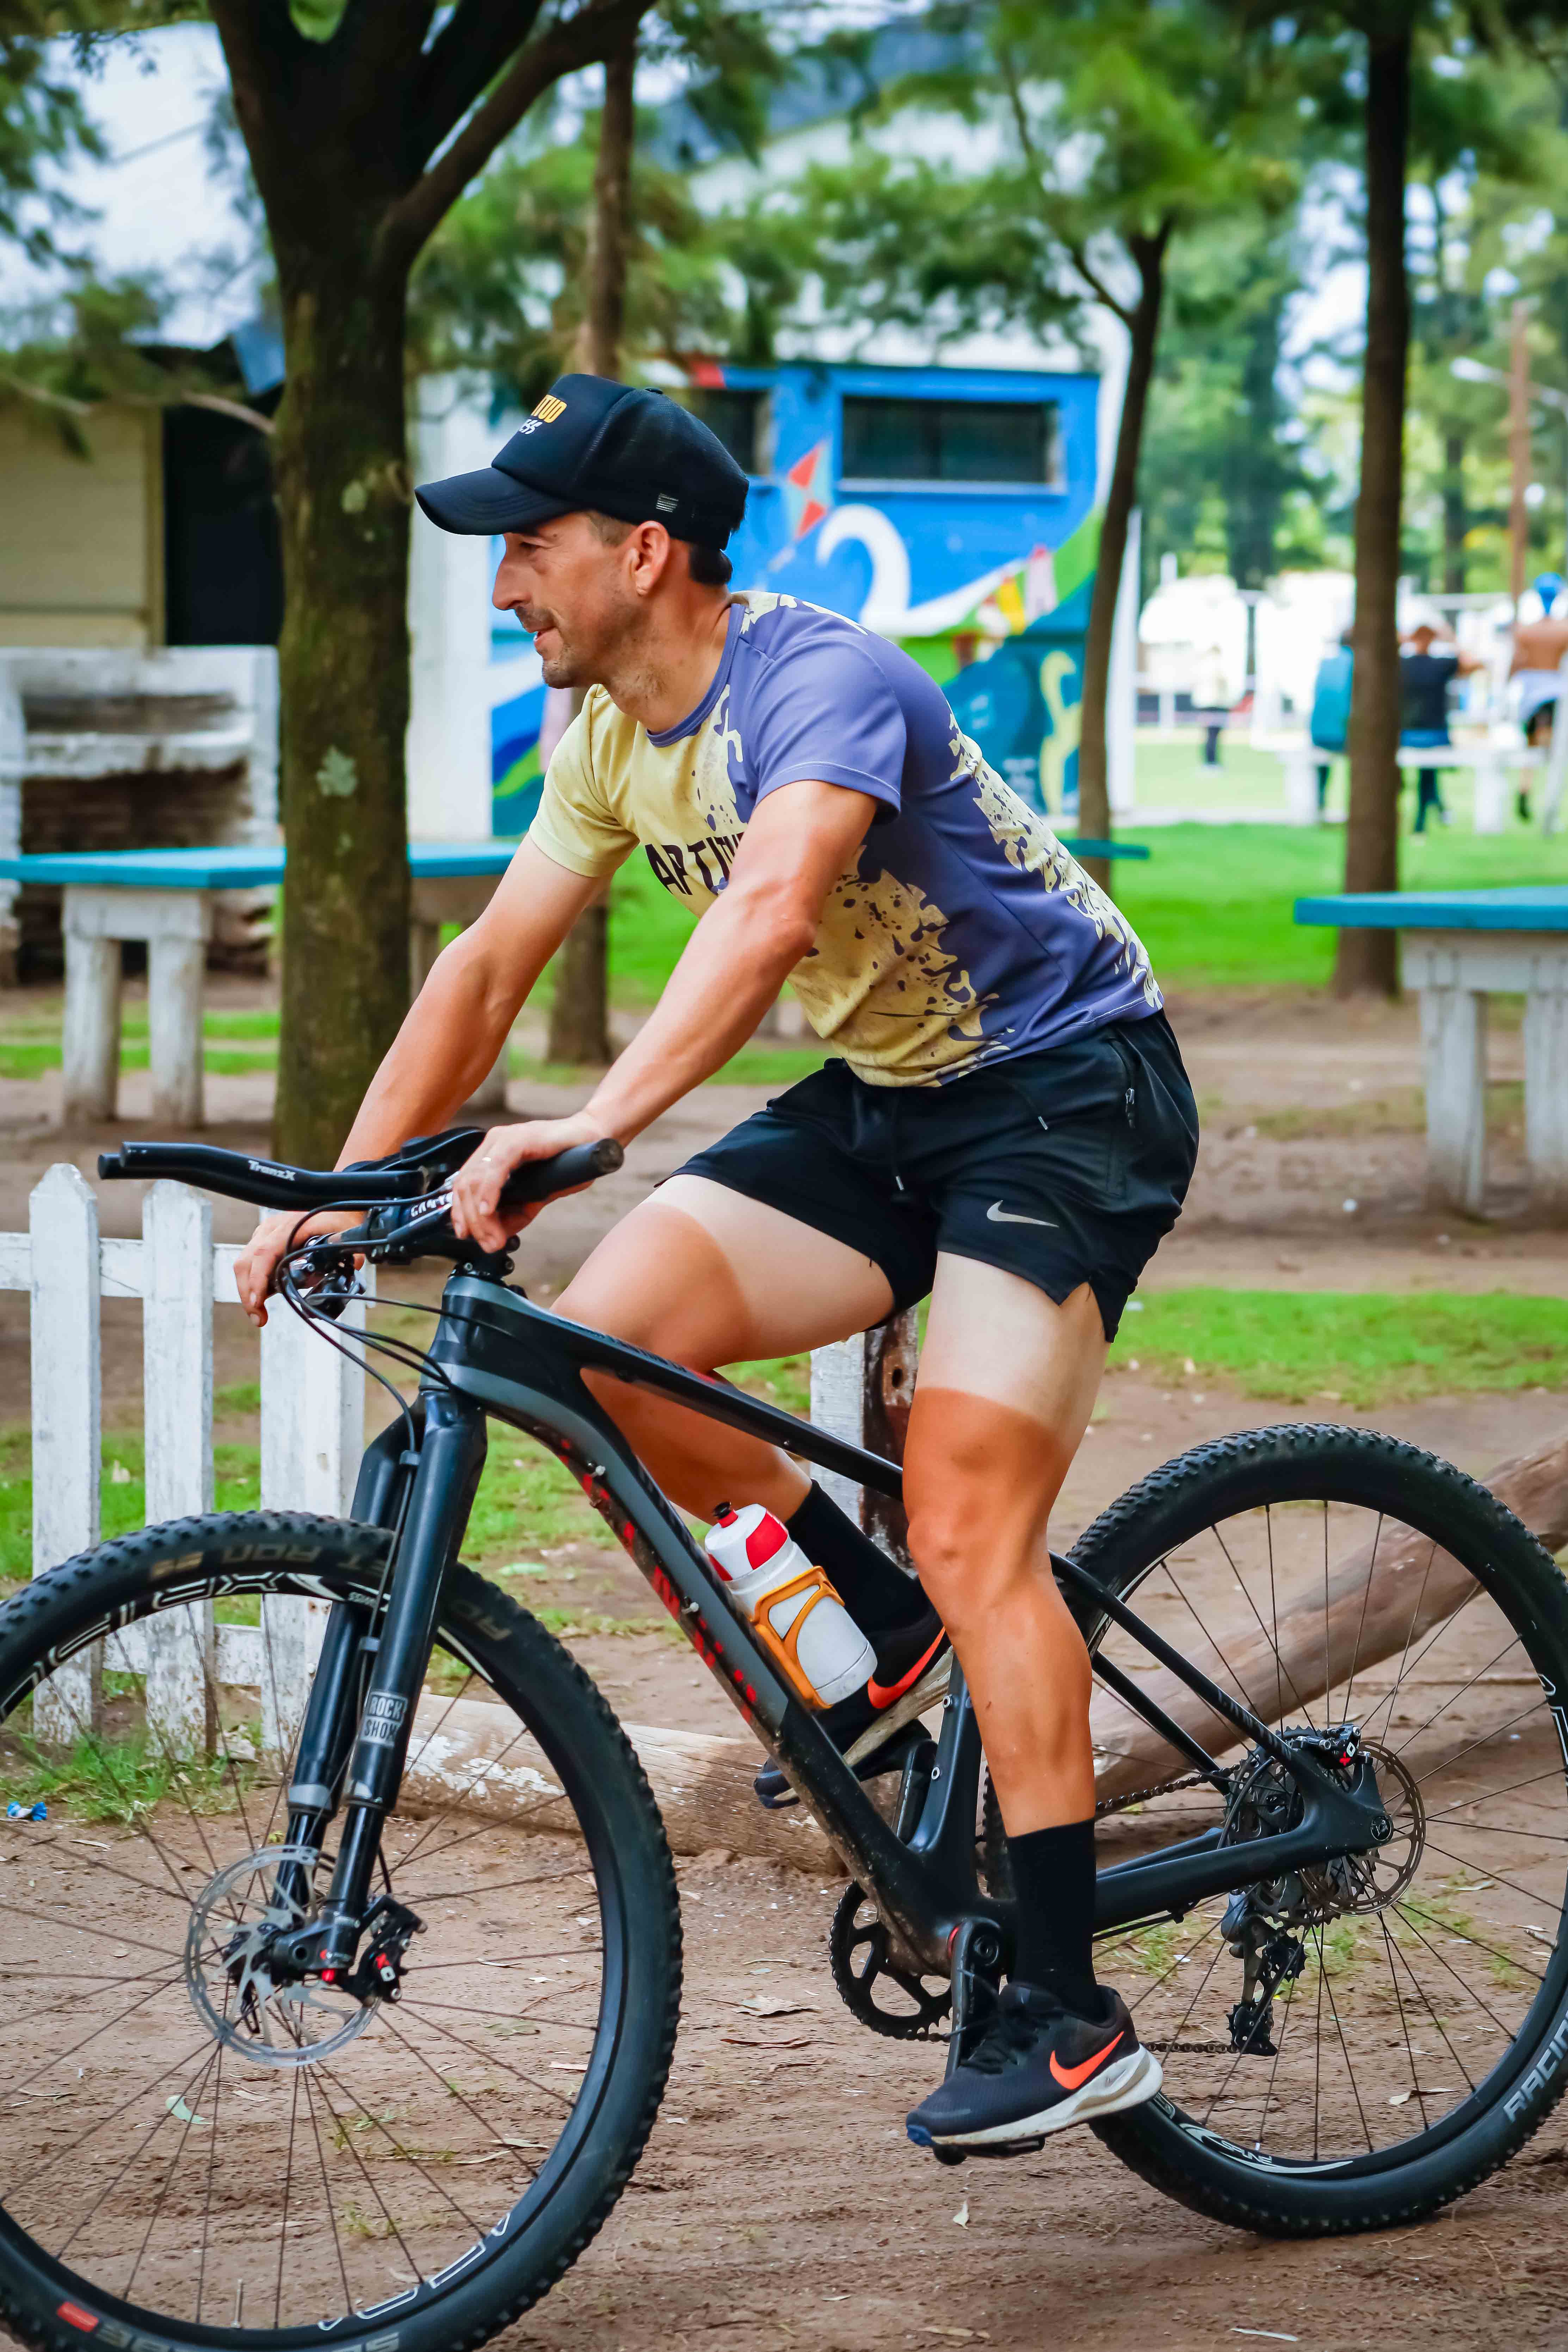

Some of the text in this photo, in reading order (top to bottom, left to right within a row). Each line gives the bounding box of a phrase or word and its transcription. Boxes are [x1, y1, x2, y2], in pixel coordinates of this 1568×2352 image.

[368, 1696, 403, 1720] ROCK
[364, 1718, 401, 1741] SHOX
[1503, 2009, 1568, 2123] RACIN
